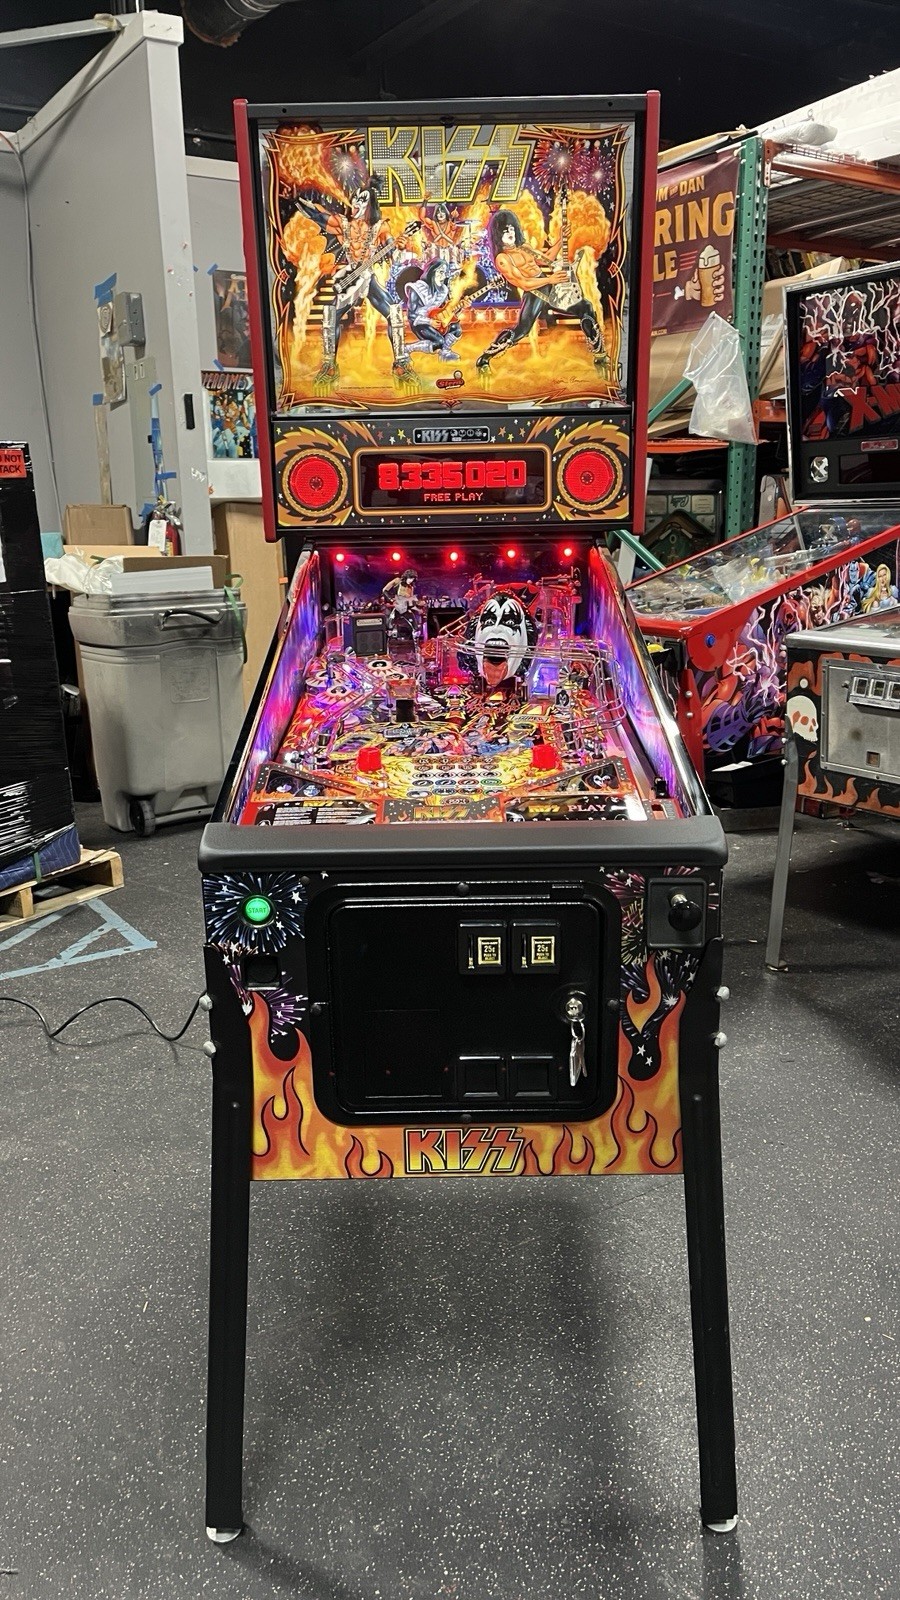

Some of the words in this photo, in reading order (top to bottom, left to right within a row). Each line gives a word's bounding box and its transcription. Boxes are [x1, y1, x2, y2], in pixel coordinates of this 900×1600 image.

[367, 124, 532, 203] KISS
[679, 176, 705, 196] DAN
[654, 191, 735, 248] RING
[421, 430, 449, 443] KISS
[5, 455, 22, 463] NOT
[424, 493, 451, 502] FREE
[455, 492, 484, 501] PLAY
[567, 804, 607, 812] PLAY
[405, 1128, 524, 1174] KISS
